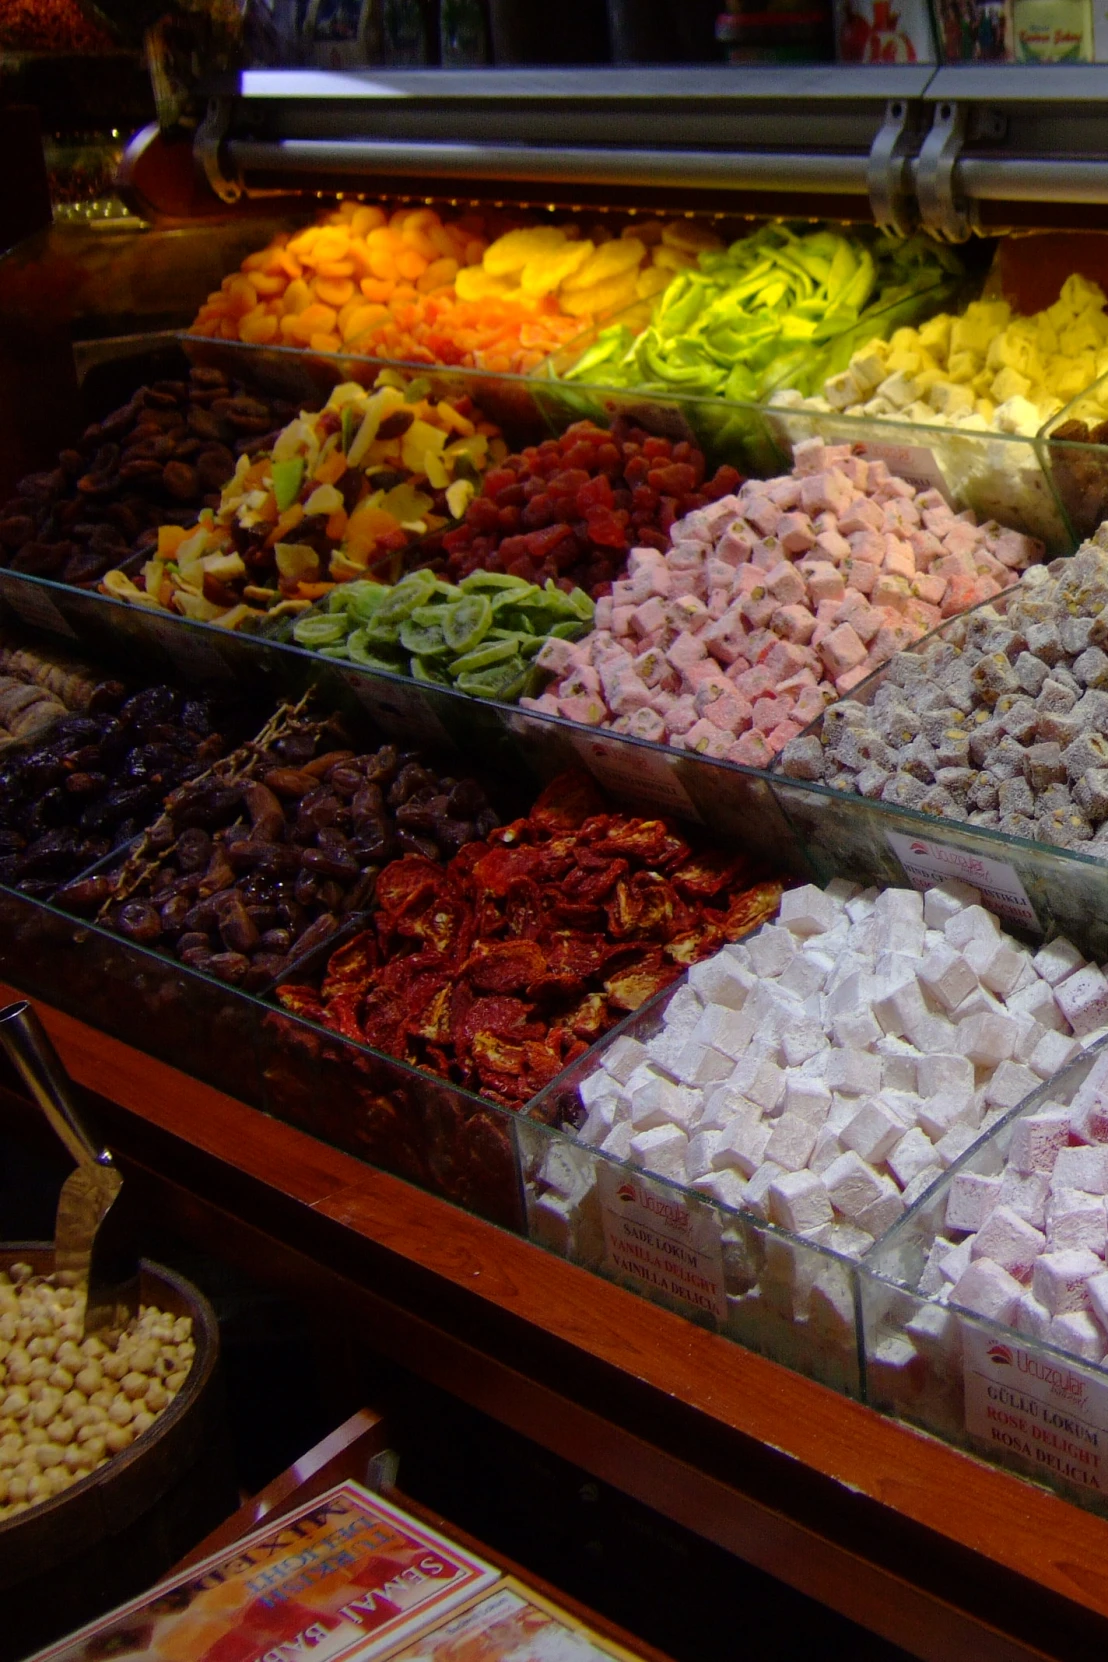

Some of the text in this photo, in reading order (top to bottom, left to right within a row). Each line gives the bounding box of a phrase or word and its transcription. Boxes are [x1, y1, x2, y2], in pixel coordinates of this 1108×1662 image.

[610, 1233, 718, 1294] VANILLA DELIGHT
[987, 1386, 1039, 1418] GÜLLÜ
[1043, 1409, 1099, 1447] LOKUM
[987, 1405, 1101, 1469] ROSE DELIGHT
[991, 1427, 1101, 1489] ROSA DELICIA
[245, 1516, 375, 1593] DELIGHT
[257, 1530, 397, 1610] TURKISH
